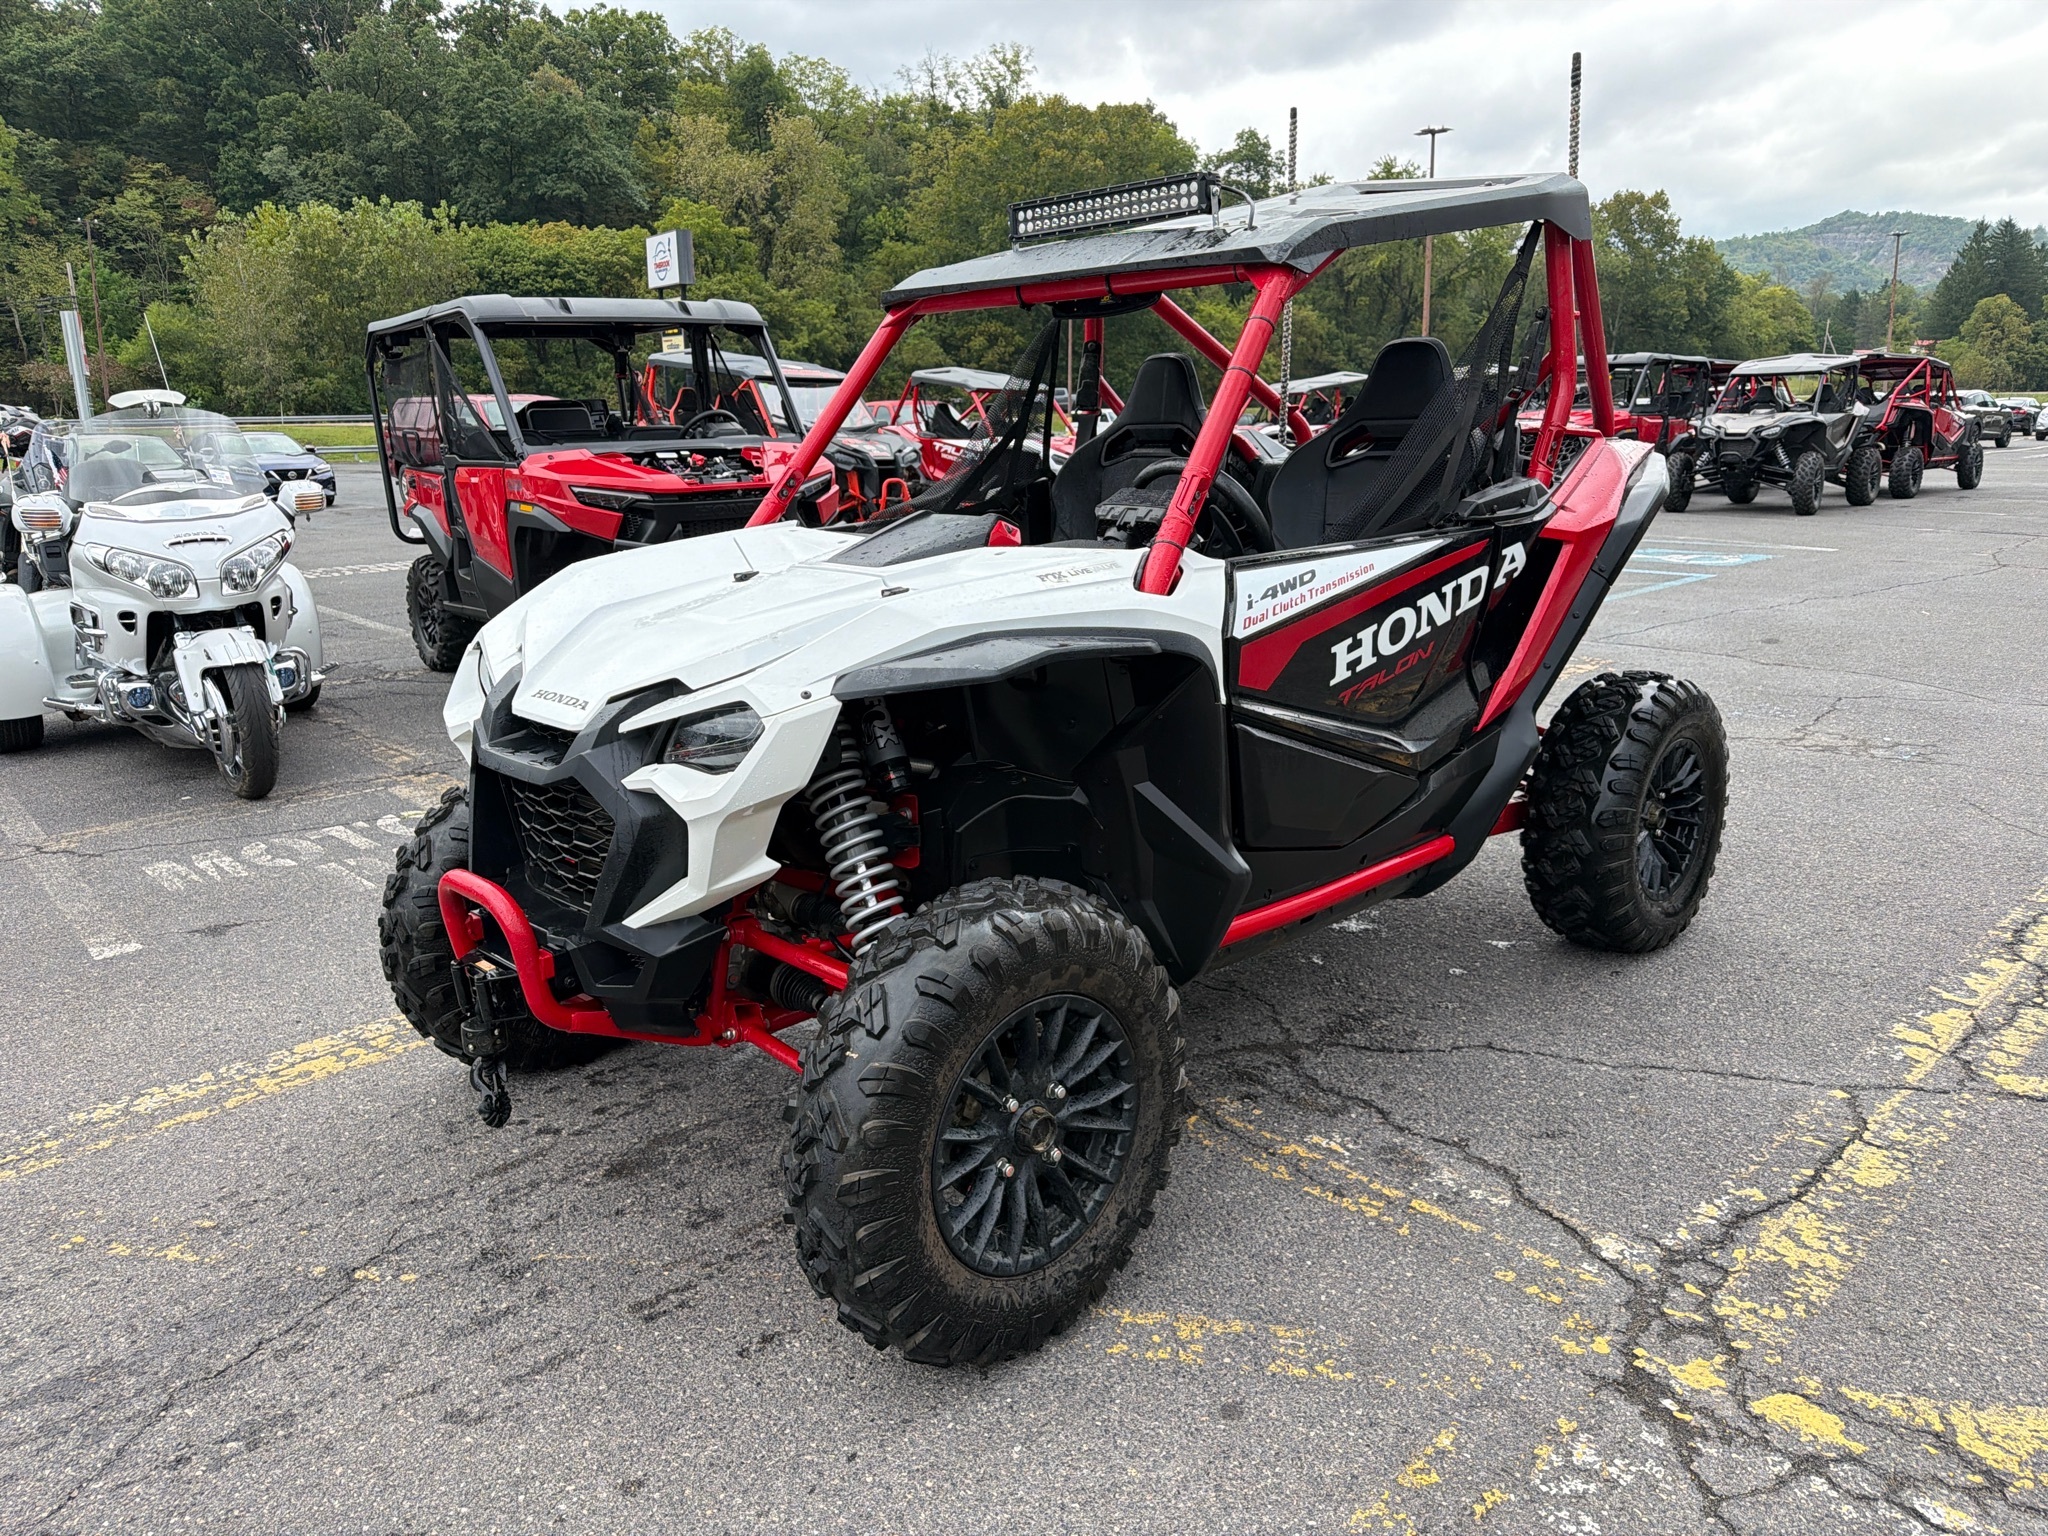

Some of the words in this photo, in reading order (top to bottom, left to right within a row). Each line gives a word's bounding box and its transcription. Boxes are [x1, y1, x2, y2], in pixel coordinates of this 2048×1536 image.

[1242, 611, 1270, 631] Dual
[1272, 594, 1307, 617] Clutch
[1308, 562, 1376, 600] Transmission
[1246, 568, 1316, 611] i-4WD
[1329, 541, 1527, 687] HONDA
[531, 689, 590, 711] HONDA
[1338, 641, 1435, 706] TALON
[862, 696, 901, 750] FOX
